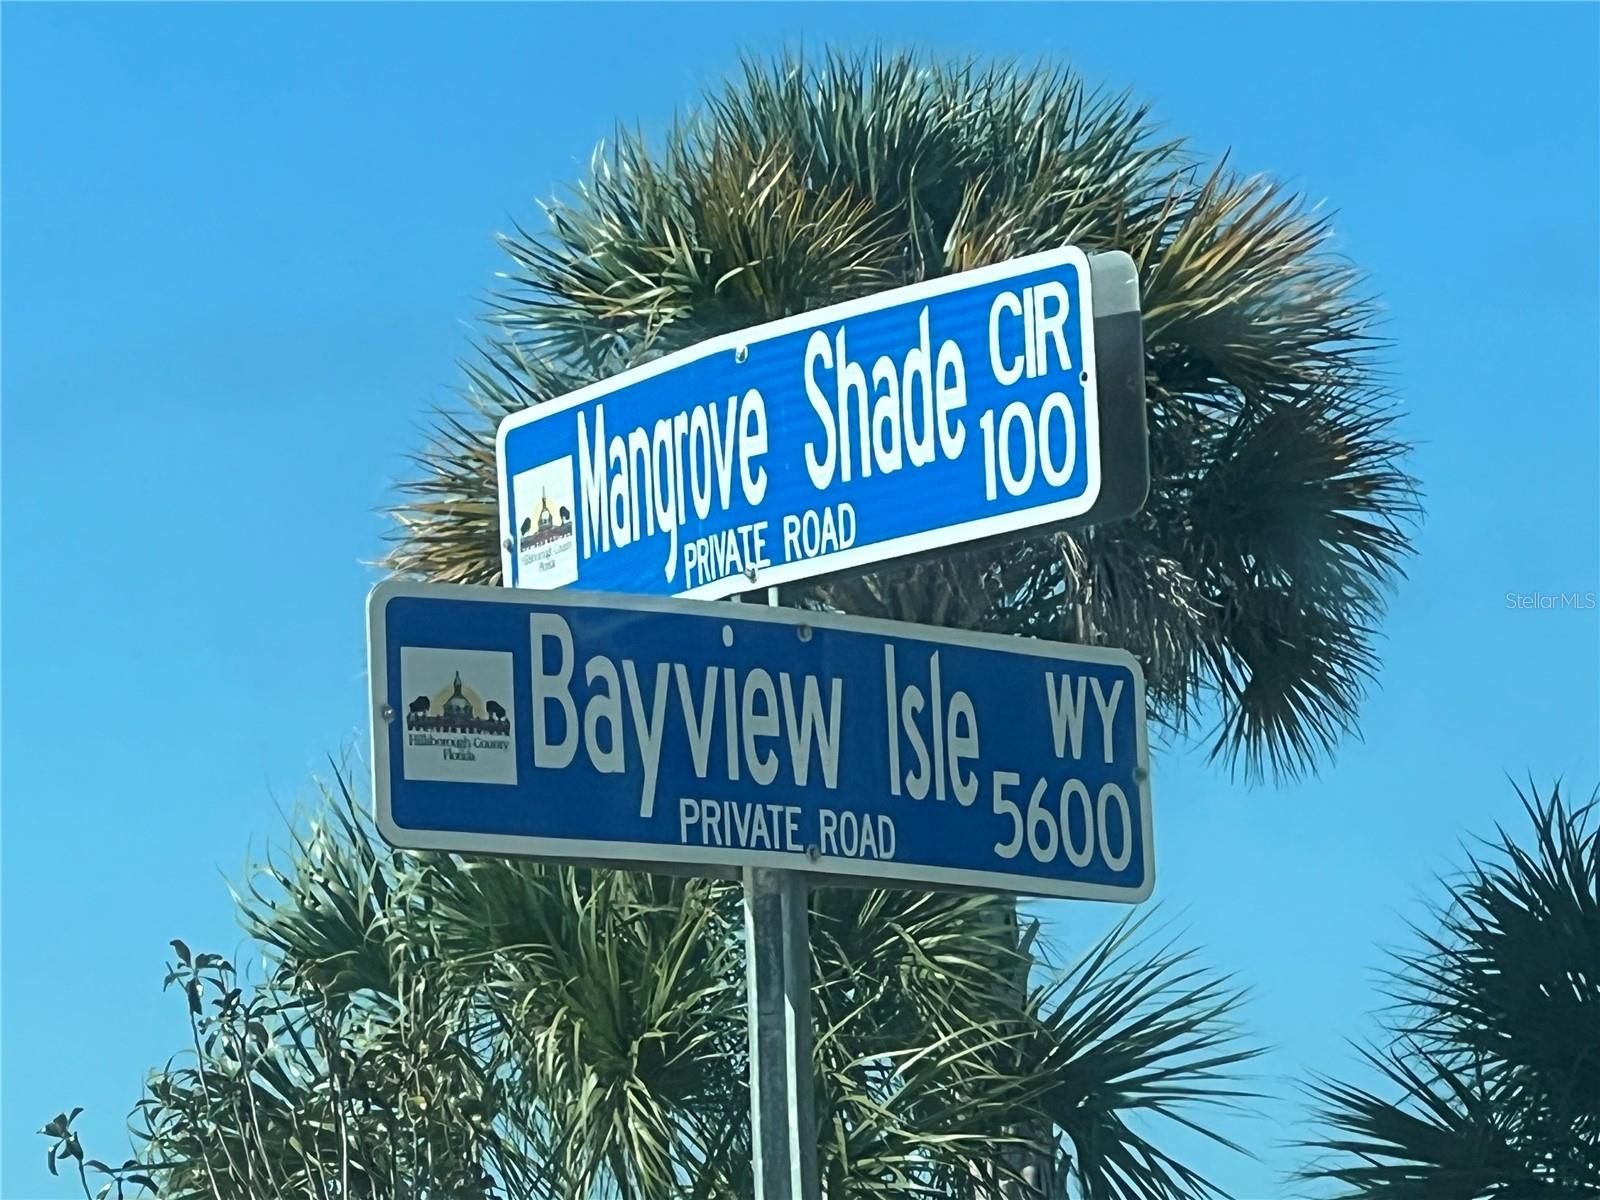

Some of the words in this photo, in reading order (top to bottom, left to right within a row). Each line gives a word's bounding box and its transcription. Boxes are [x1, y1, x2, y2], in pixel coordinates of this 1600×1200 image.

[989, 281, 1072, 386] CIR
[577, 388, 768, 583] Mangrove
[804, 305, 967, 490] Shade
[979, 391, 1076, 501] 100
[684, 520, 771, 589] PRIVATE
[783, 502, 857, 562] ROAD
[473, 737, 510, 752] County
[529, 612, 843, 818] Bayview
[884, 643, 980, 806] Isle
[1045, 671, 1124, 764] WY
[679, 798, 804, 852] PRIVATE
[819, 809, 896, 860] ROAD
[993, 771, 1132, 872] 5600
